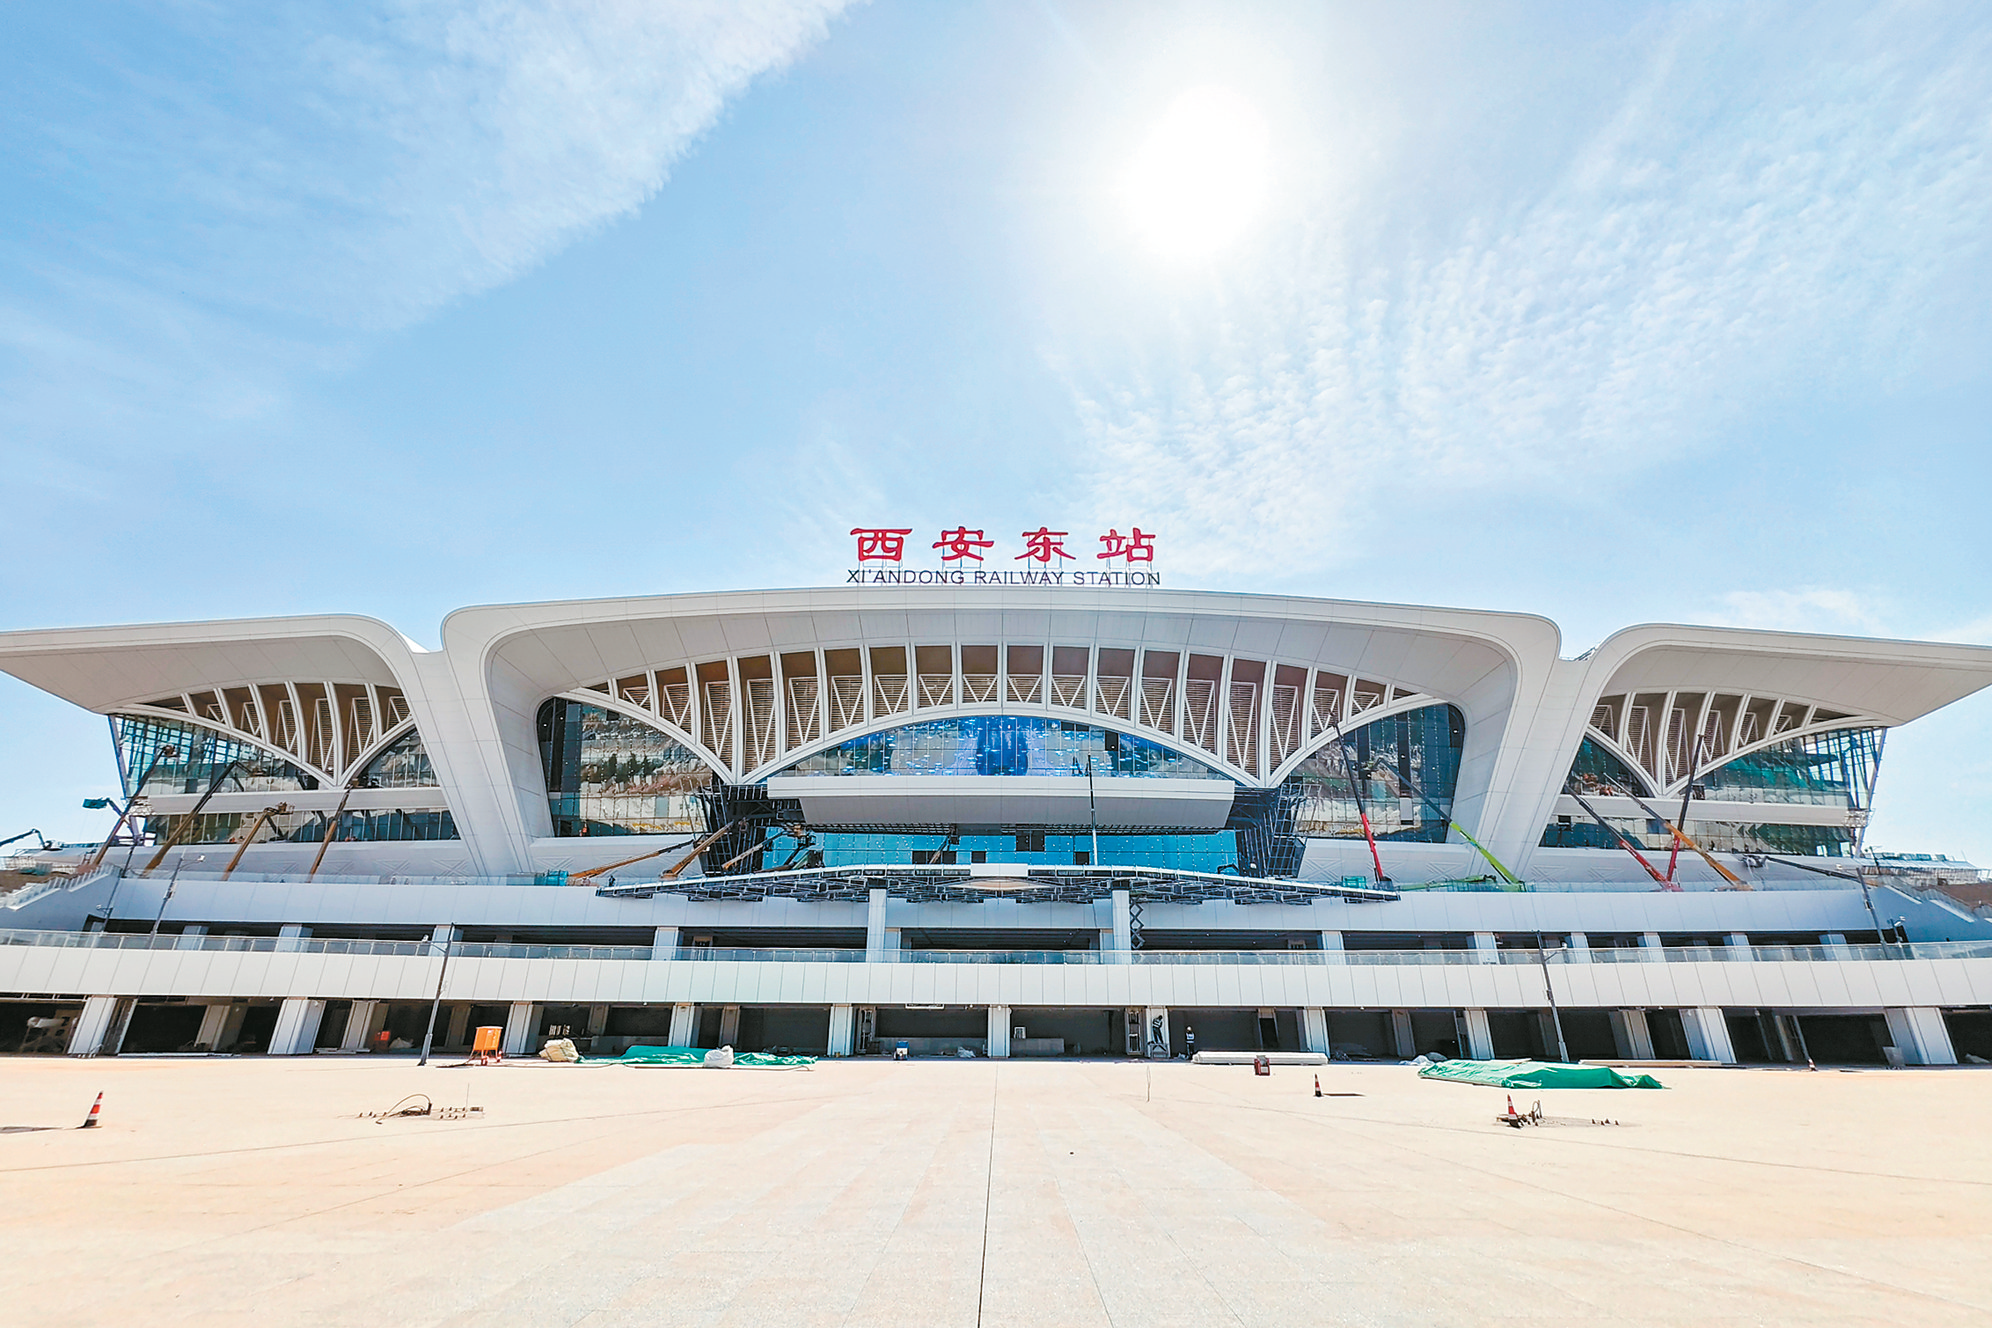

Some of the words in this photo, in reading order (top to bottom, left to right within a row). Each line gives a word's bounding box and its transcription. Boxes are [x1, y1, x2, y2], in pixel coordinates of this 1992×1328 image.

[850, 526, 1156, 562] 西安东站
[846, 569, 965, 585] XI'ANDONG
[974, 570, 1065, 585] RAILWAY
[1073, 571, 1161, 586] STATION
